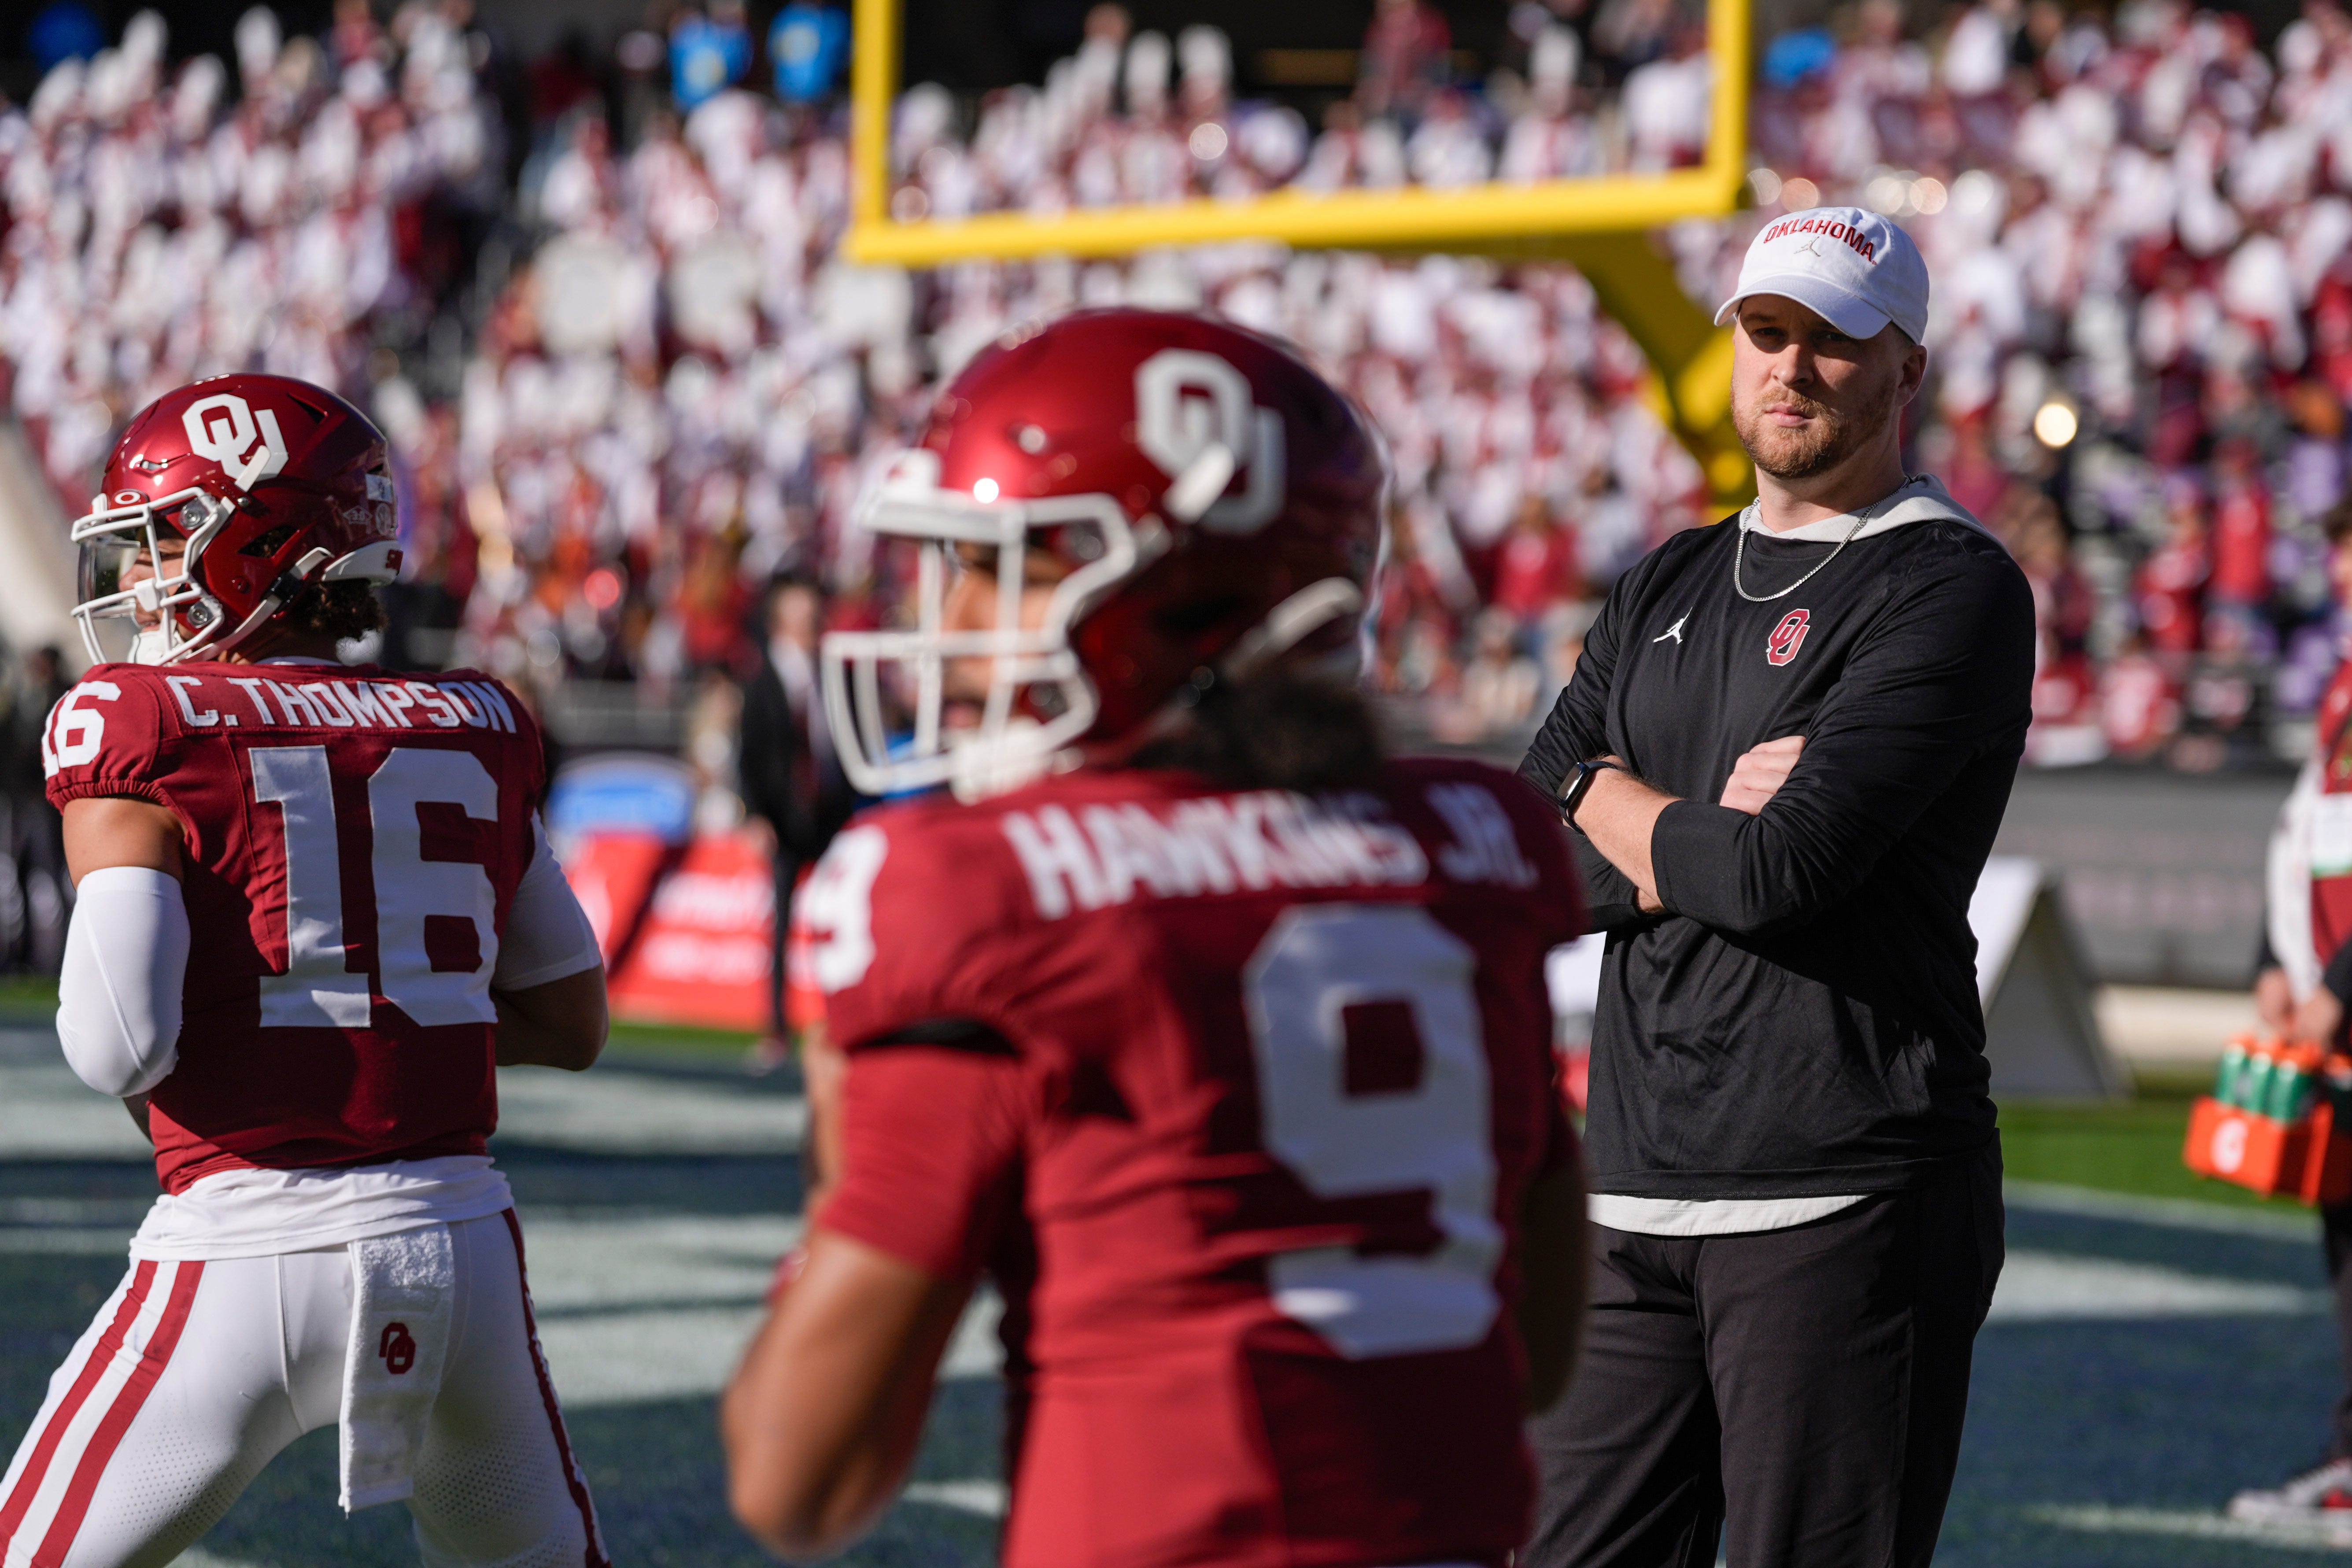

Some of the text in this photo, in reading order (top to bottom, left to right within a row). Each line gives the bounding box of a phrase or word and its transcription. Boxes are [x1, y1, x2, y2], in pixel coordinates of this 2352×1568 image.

[1764, 219, 1877, 265] OKLAHOMA
[181, 393, 289, 480] OU
[1767, 608, 1810, 666] OU
[41, 680, 122, 781] 16
[248, 745, 498, 1028] 16
[792, 823, 890, 995] 9
[1243, 904, 1506, 1361] 9
